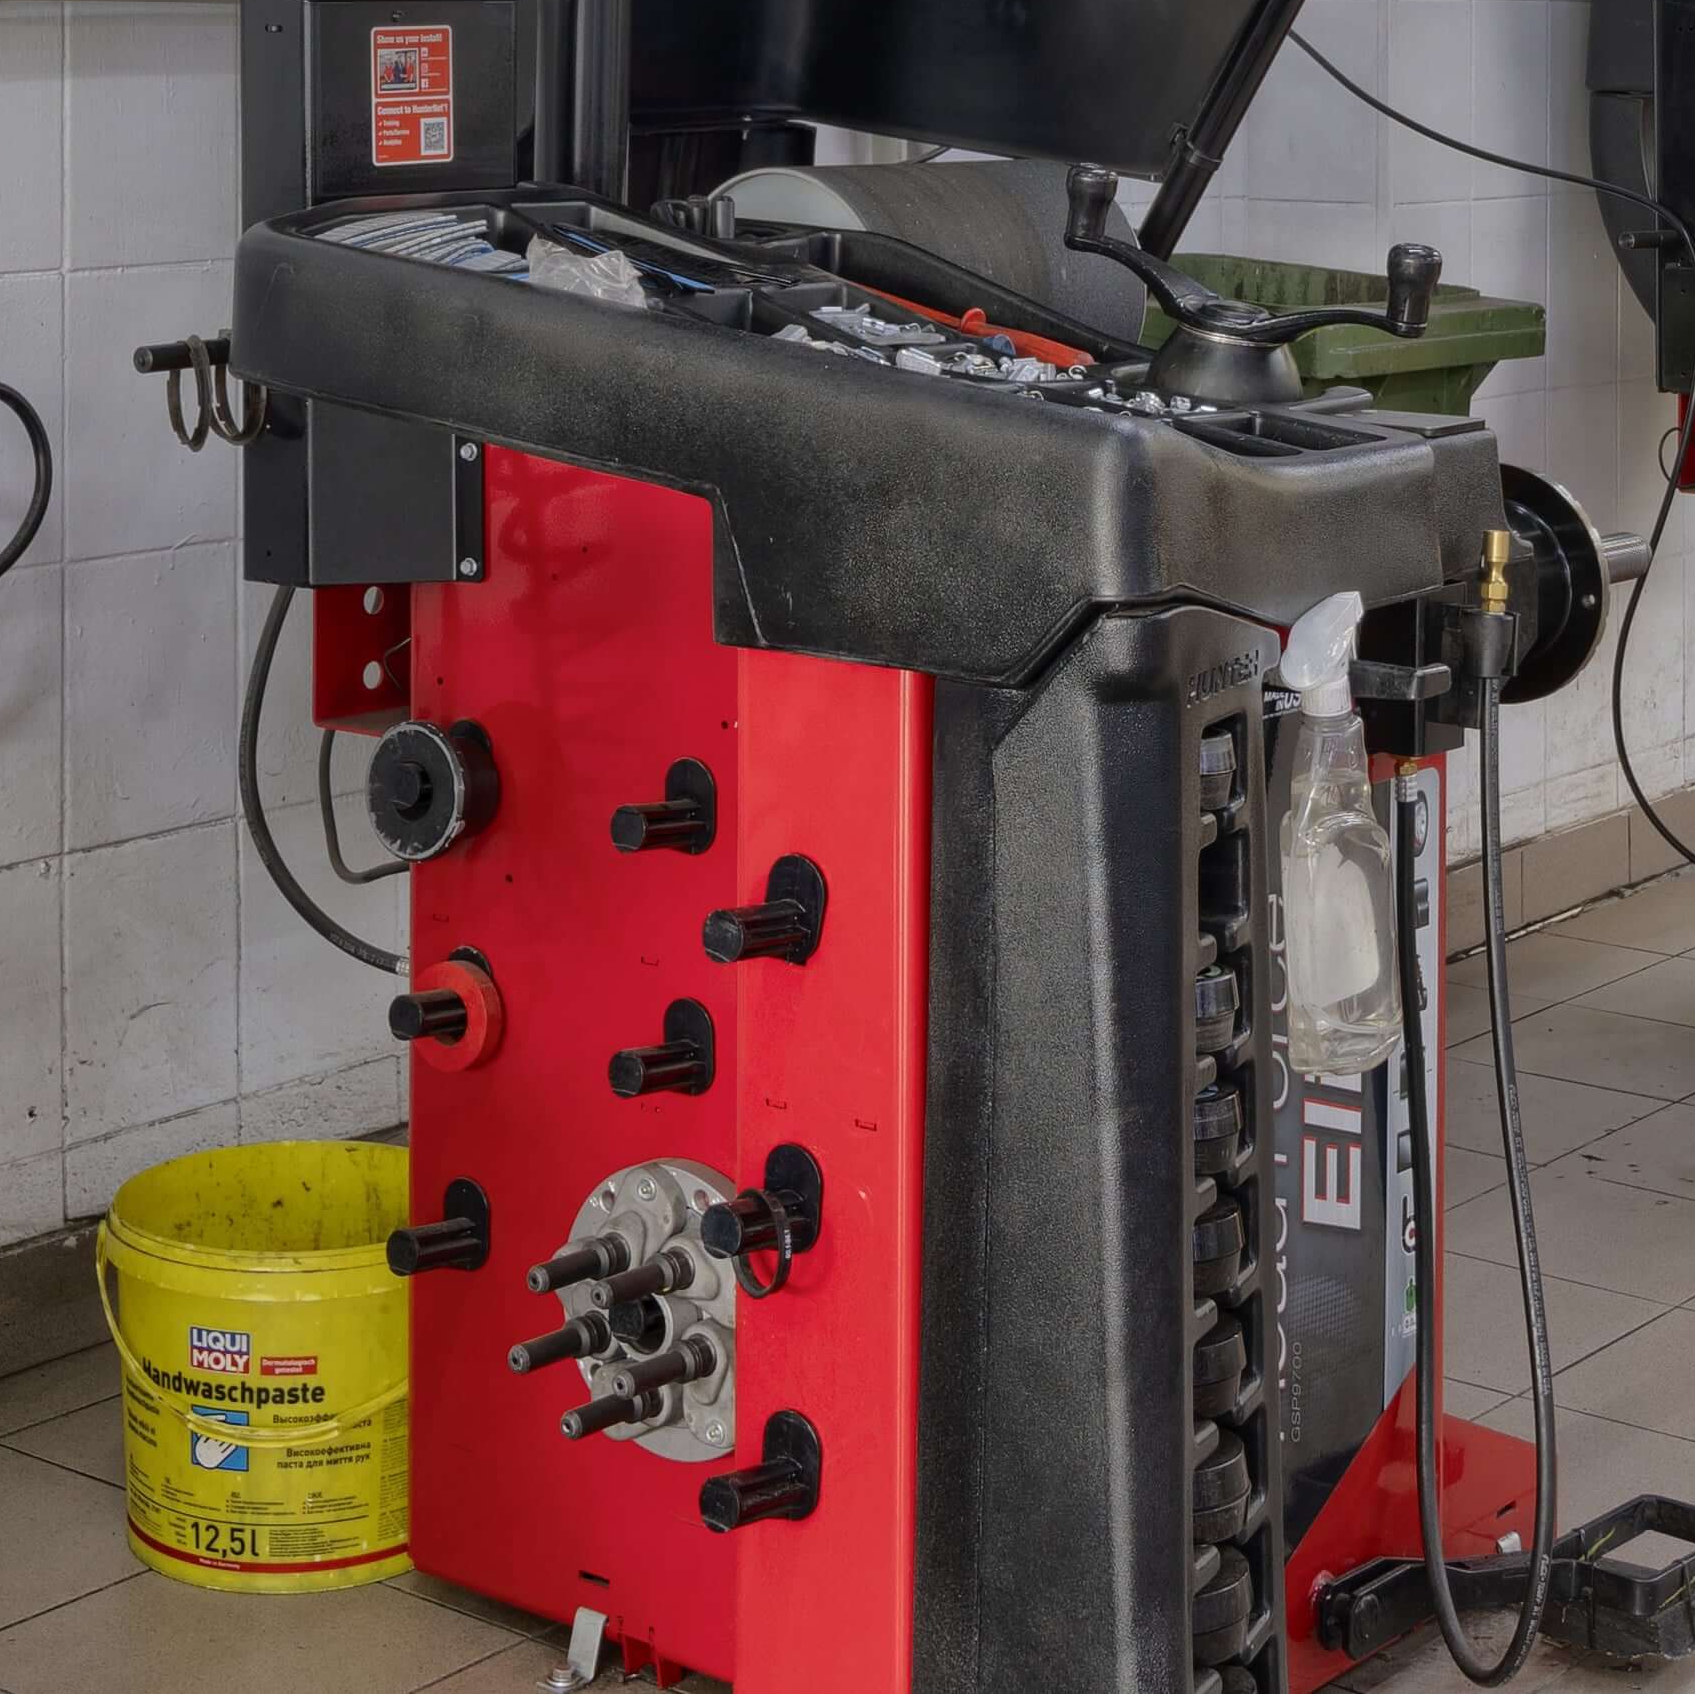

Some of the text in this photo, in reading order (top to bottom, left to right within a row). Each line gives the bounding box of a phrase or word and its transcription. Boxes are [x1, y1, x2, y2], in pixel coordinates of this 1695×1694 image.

[1301, 1073, 1361, 1230] Eli
[192, 1328, 248, 1352] LIQUI
[192, 1349, 249, 1373] MOLY
[142, 1357, 326, 1410] Handwaschpaste
[1290, 1341, 1303, 1443] GSP9700
[277, 1460, 303, 1468] паста
[191, 1521, 246, 1558] 12,5
